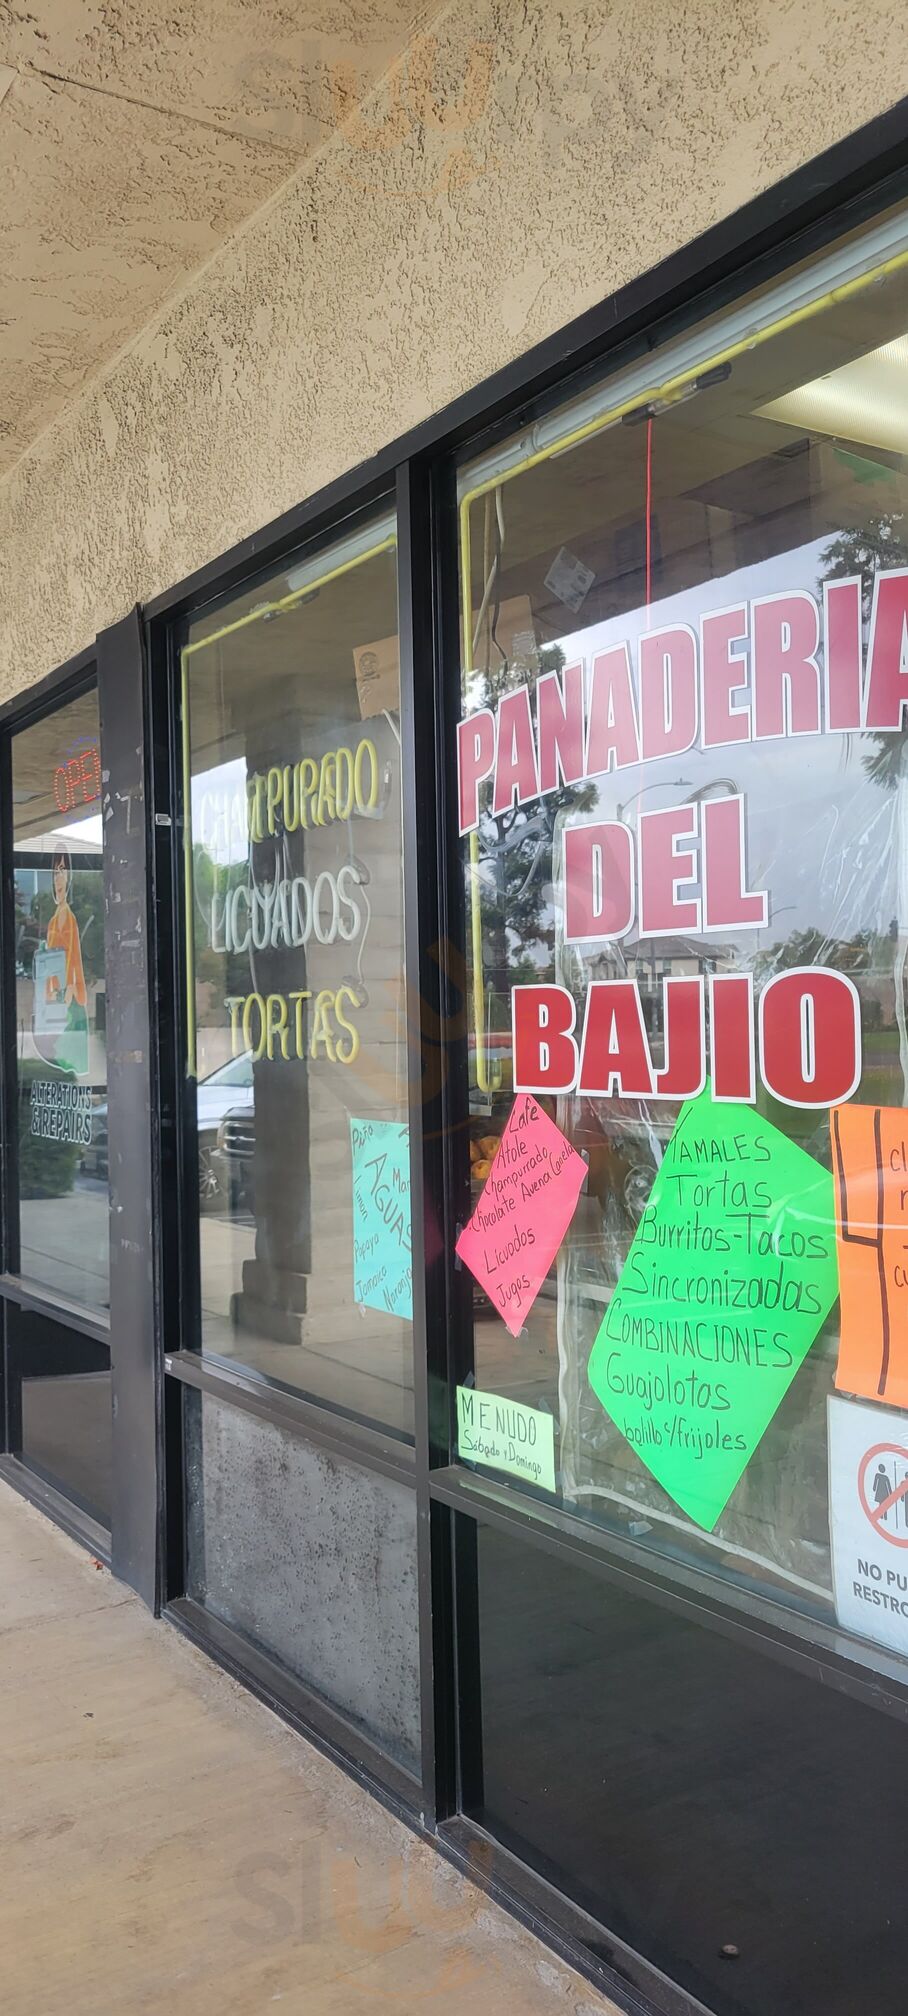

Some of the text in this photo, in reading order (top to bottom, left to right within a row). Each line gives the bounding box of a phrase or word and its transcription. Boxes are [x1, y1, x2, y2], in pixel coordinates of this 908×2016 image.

[457, 567, 908, 837] PANADERIA
[561, 793, 769, 945] DEL
[210, 864, 362, 954] LICUADOS
[224, 984, 361, 1064] TORTAS
[512, 966, 862, 1108] BAJIO
[30, 1079, 92, 1112] ALTERATIONS
[42, 1106, 92, 1145] REPAIRS
[496, 1134, 528, 1169] Atole
[669, 1106, 772, 1164] TAMALES
[520, 1171, 553, 1203] Avena
[666, 1170, 773, 1208] Tortas
[484, 1224, 537, 1275] Licuados
[833, 1109, 891, 1397] 4
[496, 1274, 531, 1308] Jugos
[622, 1251, 822, 1315] Sincronizadas
[605, 1297, 794, 1368] COMBINACIONES
[461, 1392, 537, 1446] MENUDO
[508, 1441, 542, 1480] Domingo
[857, 1558, 882, 1581] NO
